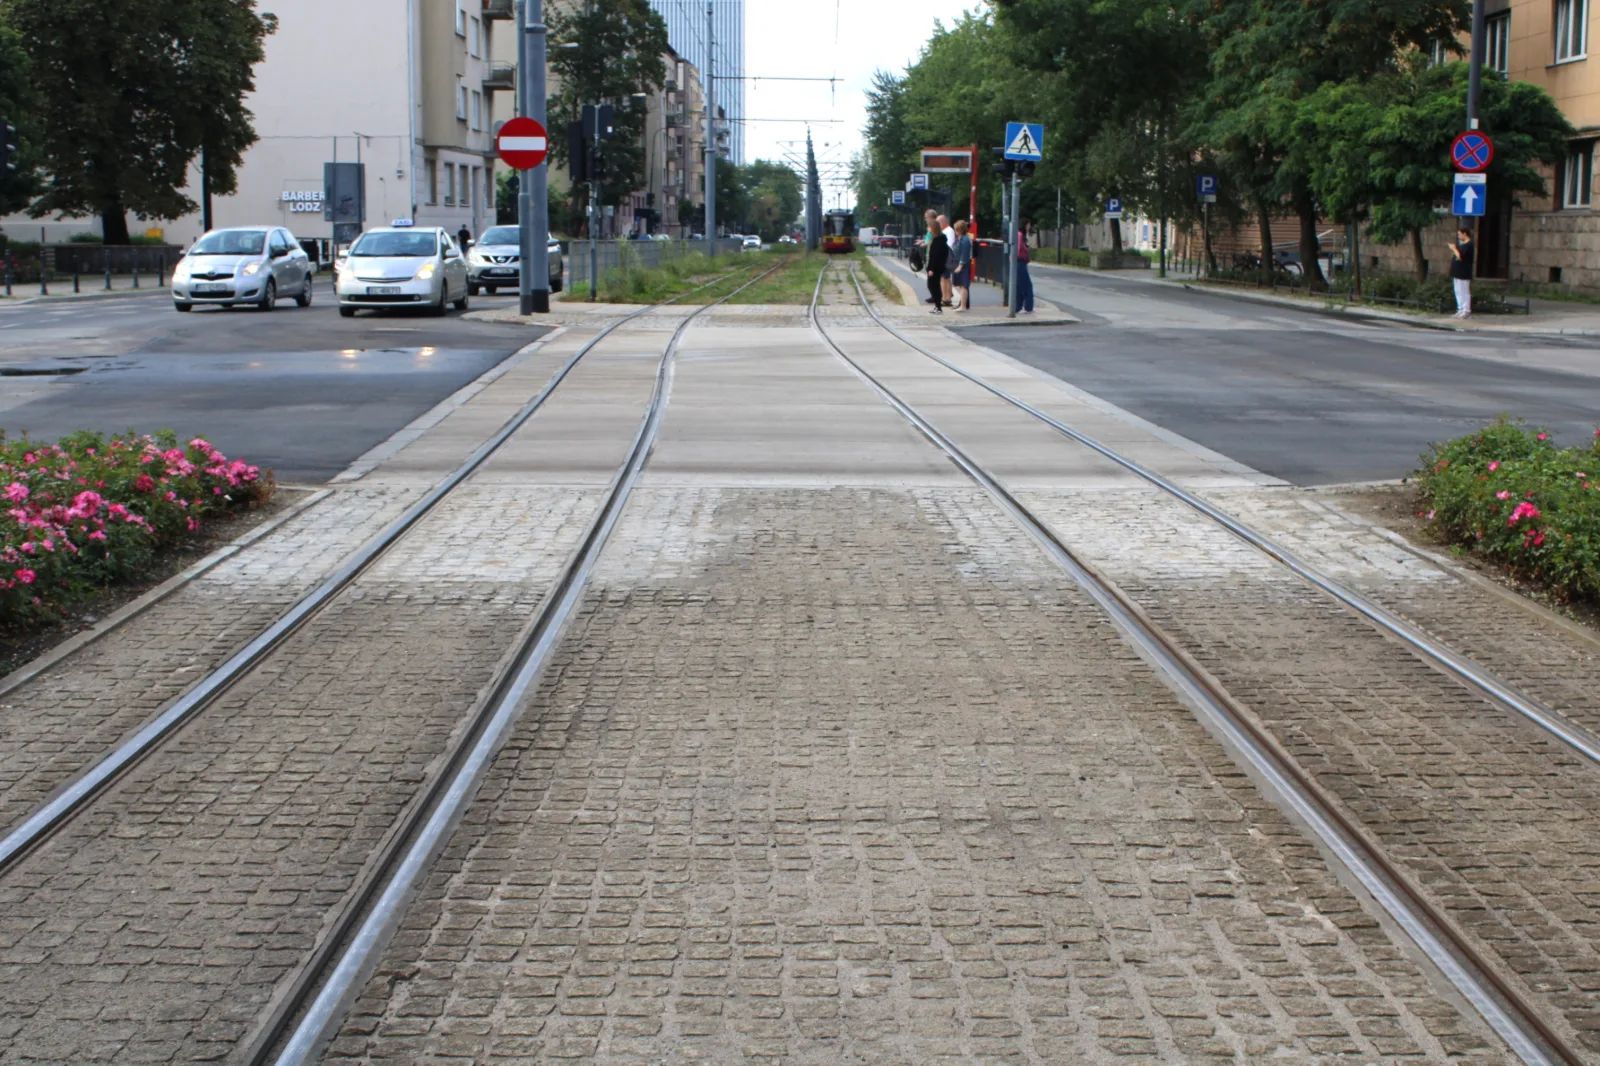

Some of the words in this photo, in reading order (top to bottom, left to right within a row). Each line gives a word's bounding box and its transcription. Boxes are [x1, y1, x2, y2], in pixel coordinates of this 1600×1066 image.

[1201, 176, 1213, 192] P
[282, 191, 325, 201] BARBER
[1109, 199, 1119, 211] P
